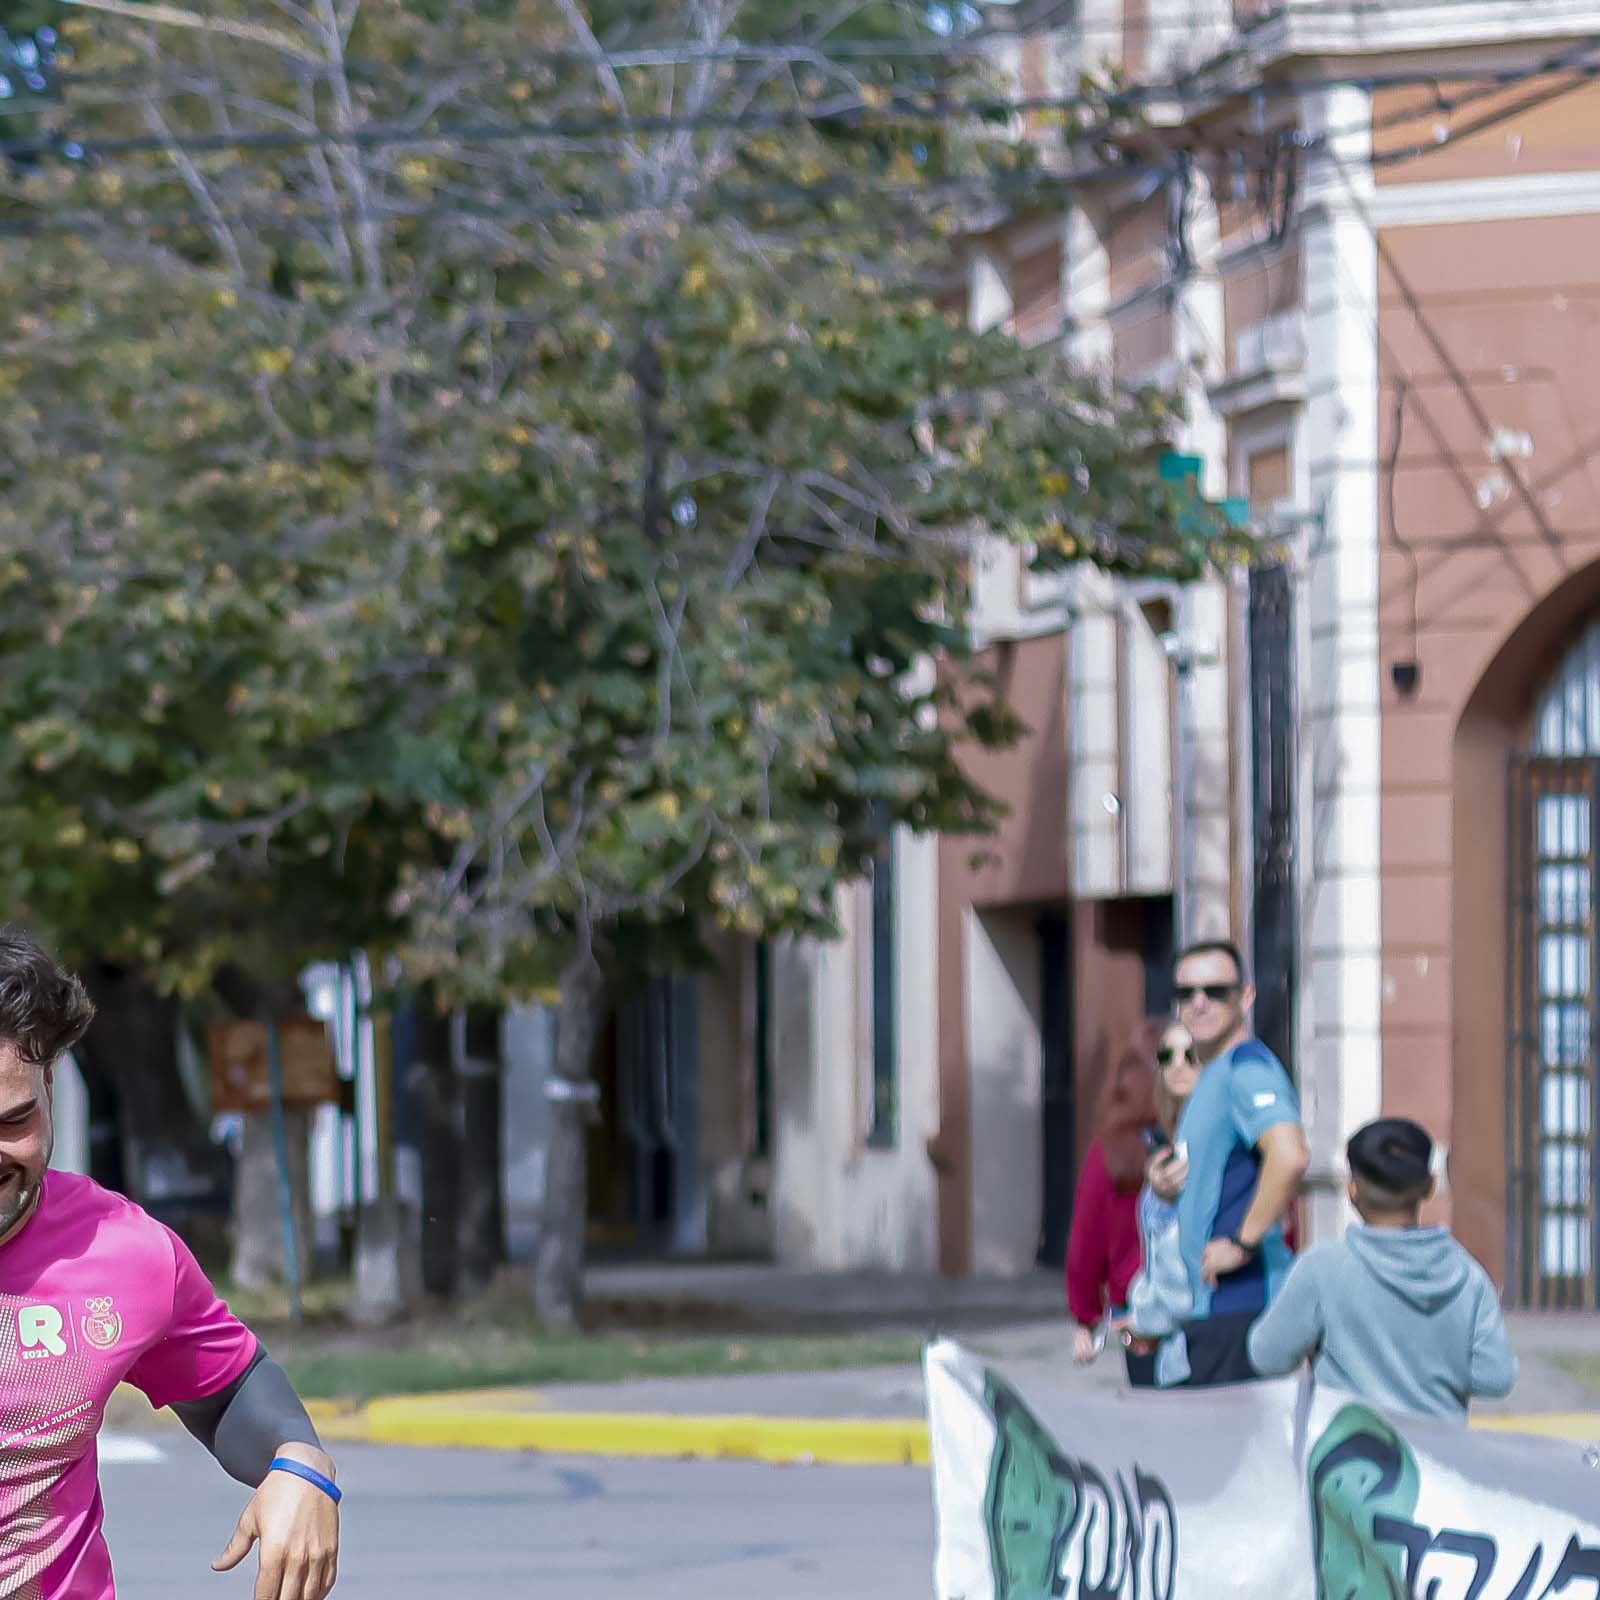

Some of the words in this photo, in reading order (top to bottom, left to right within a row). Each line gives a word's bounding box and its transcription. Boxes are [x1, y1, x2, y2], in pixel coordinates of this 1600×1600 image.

[18, 1304, 67, 1356] R
[22, 1348, 49, 1360] 2022
[25, 1426, 38, 1436] DE
[38, 1421, 50, 1431] LA
[50, 1400, 93, 1425] JUVENTUD
